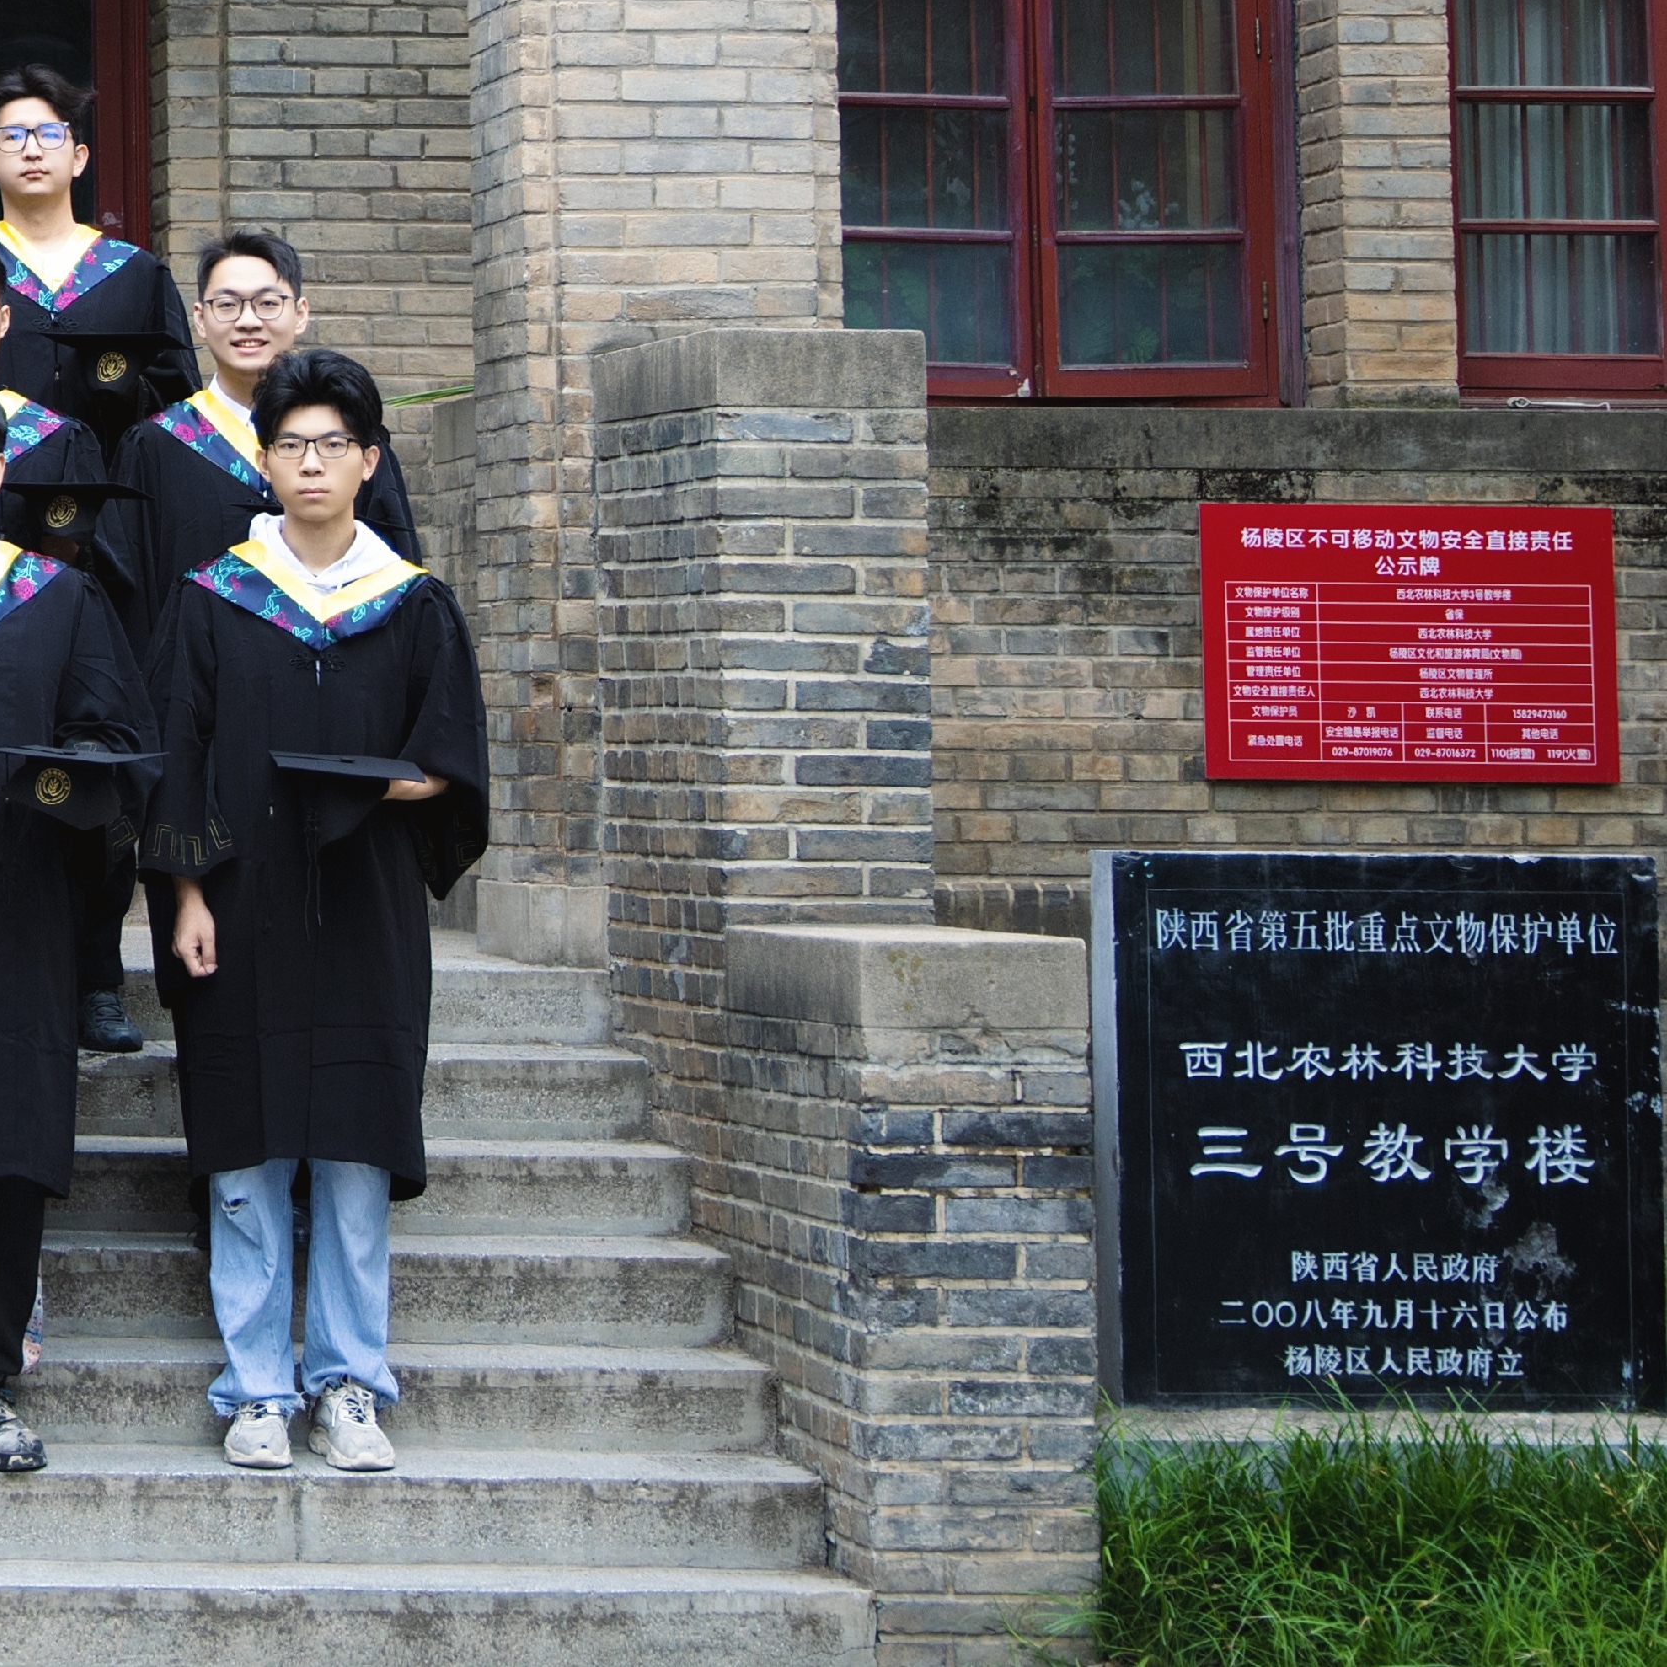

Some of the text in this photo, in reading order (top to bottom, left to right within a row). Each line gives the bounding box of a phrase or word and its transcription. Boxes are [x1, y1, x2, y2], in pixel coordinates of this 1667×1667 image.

[1240, 527, 1573, 552] 杨陵区不可移动文物安全直接责任
[1374, 555, 1441, 576] 公示牌
[1235, 586, 1309, 599] 文物保护单位名称
[1244, 605, 1301, 619] 文物保护级别
[1444, 608, 1464, 621] 省保
[1417, 627, 1492, 641] 西北农林科技大学
[1233, 684, 1315, 697] 文物安全直接责任人
[1419, 687, 1494, 700] 西北农林科技大学
[1425, 706, 1462, 719] 联系电话
[1521, 727, 1558, 740] 其他电话
[1155, 907, 1618, 958] 陕西省第五批重点文物保护单位
[1178, 1040, 1597, 1082] 西北农林科技大学
[1190, 1122, 1595, 1185] 三号教学楼
[1291, 1250, 1499, 1284] 陕西省人民政府
[1284, 1343, 1524, 1378] 杨陵区人民政府立
